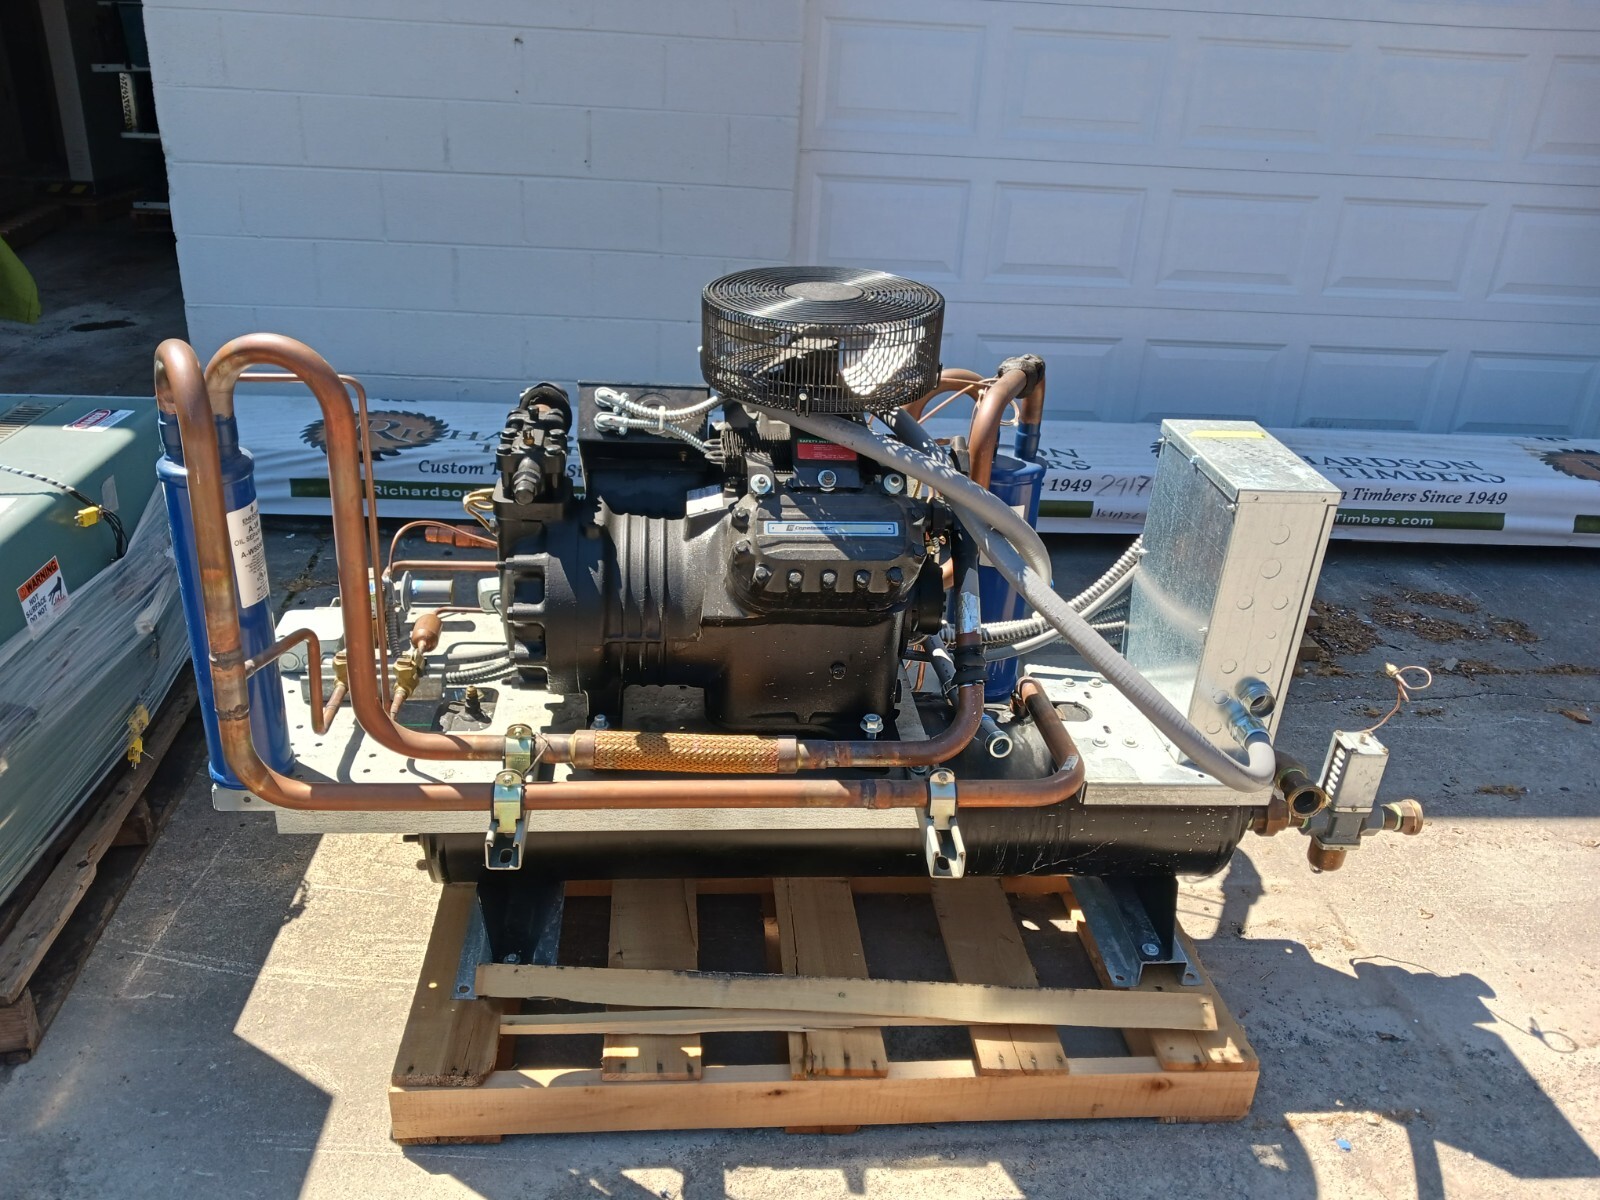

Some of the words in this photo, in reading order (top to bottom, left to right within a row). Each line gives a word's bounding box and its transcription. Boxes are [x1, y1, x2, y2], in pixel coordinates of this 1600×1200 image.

[418, 459, 484, 475] Custom
[1048, 478, 1092, 493] 1949
[1352, 487, 1417, 503] Timbers
[1419, 489, 1463, 505] Since
[1466, 491, 1508, 505] 1949
[1334, 513, 1434, 526] Timbers.com
[25, 561, 58, 594] WARNING
[25, 595, 47, 619] SURFACE
[29, 593, 39, 607] HOT
[38, 604, 48, 617] NOT
